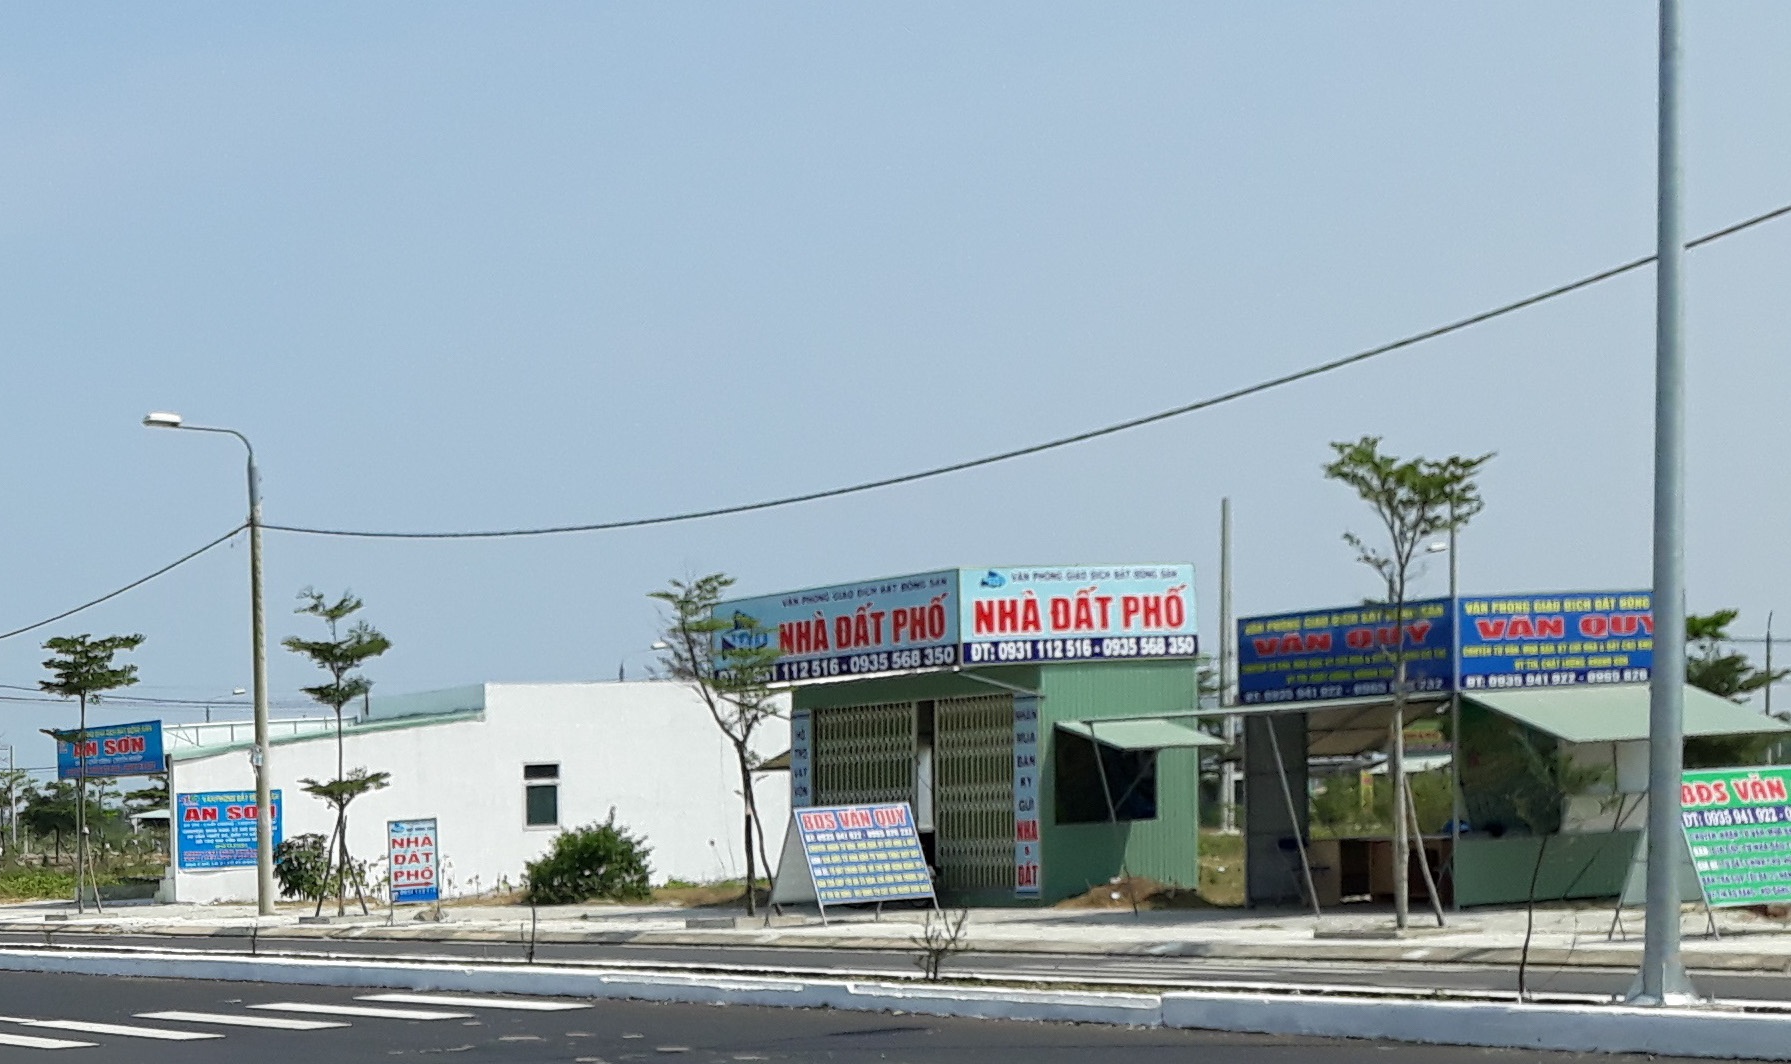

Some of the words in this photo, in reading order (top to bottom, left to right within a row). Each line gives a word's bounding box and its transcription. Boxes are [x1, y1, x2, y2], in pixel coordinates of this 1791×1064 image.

[974, 590, 1041, 634] NHÀ
[1050, 585, 1113, 630] ĐẤT
[1122, 584, 1187, 629] PHỐ
[778, 610, 829, 654] NHÀ
[835, 602, 885, 649] ĐẤT
[891, 592, 949, 643] PHỐ
[1475, 615, 1564, 640] VĂN
[999, 642, 1032, 661] 0931
[1037, 641, 1063, 658] 112
[1065, 640, 1091, 657] 516
[1103, 639, 1137, 657] 0935
[1141, 638, 1165, 655] 568
[1169, 637, 1194, 654] 350
[1253, 632, 1332, 656] VĂN
[782, 662, 808, 680] 112
[811, 658, 839, 678] 516
[850, 653, 888, 672] 0935
[892, 650, 921, 668] 568
[924, 647, 955, 665] 350
[103, 735, 145, 757] SƠN
[1730, 773, 1788, 803] VĂN
[184, 806, 218, 822] AN
[391, 834, 433, 849] NHÀ
